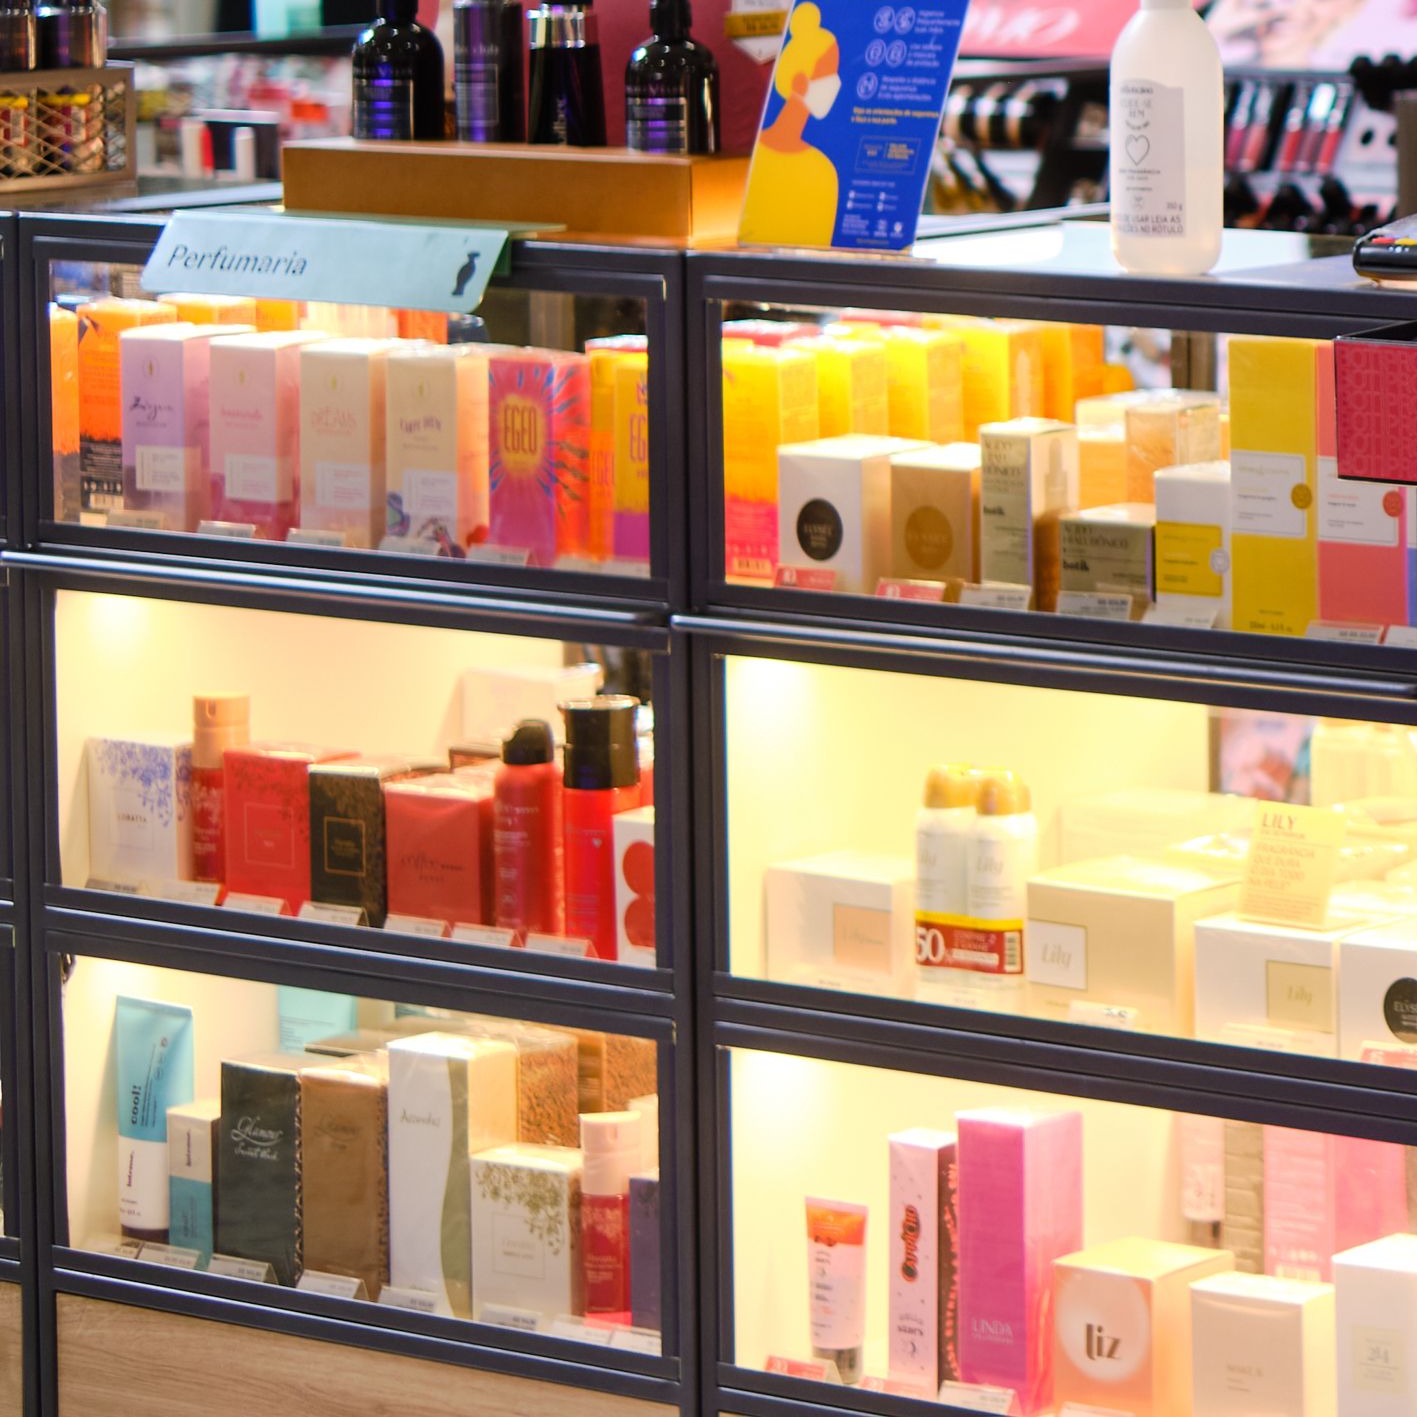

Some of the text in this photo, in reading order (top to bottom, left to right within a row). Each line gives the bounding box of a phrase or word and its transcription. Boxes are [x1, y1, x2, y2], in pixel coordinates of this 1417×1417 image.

[168, 244, 308, 278] Perfumaria
[504, 404, 537, 456] EGEO
[630, 413, 647, 462] EG
[1262, 813, 1298, 830] LILY
[1042, 943, 1073, 969] Lily
[130, 1084, 142, 1126] cool!
[1086, 1323, 1122, 1361] liz
